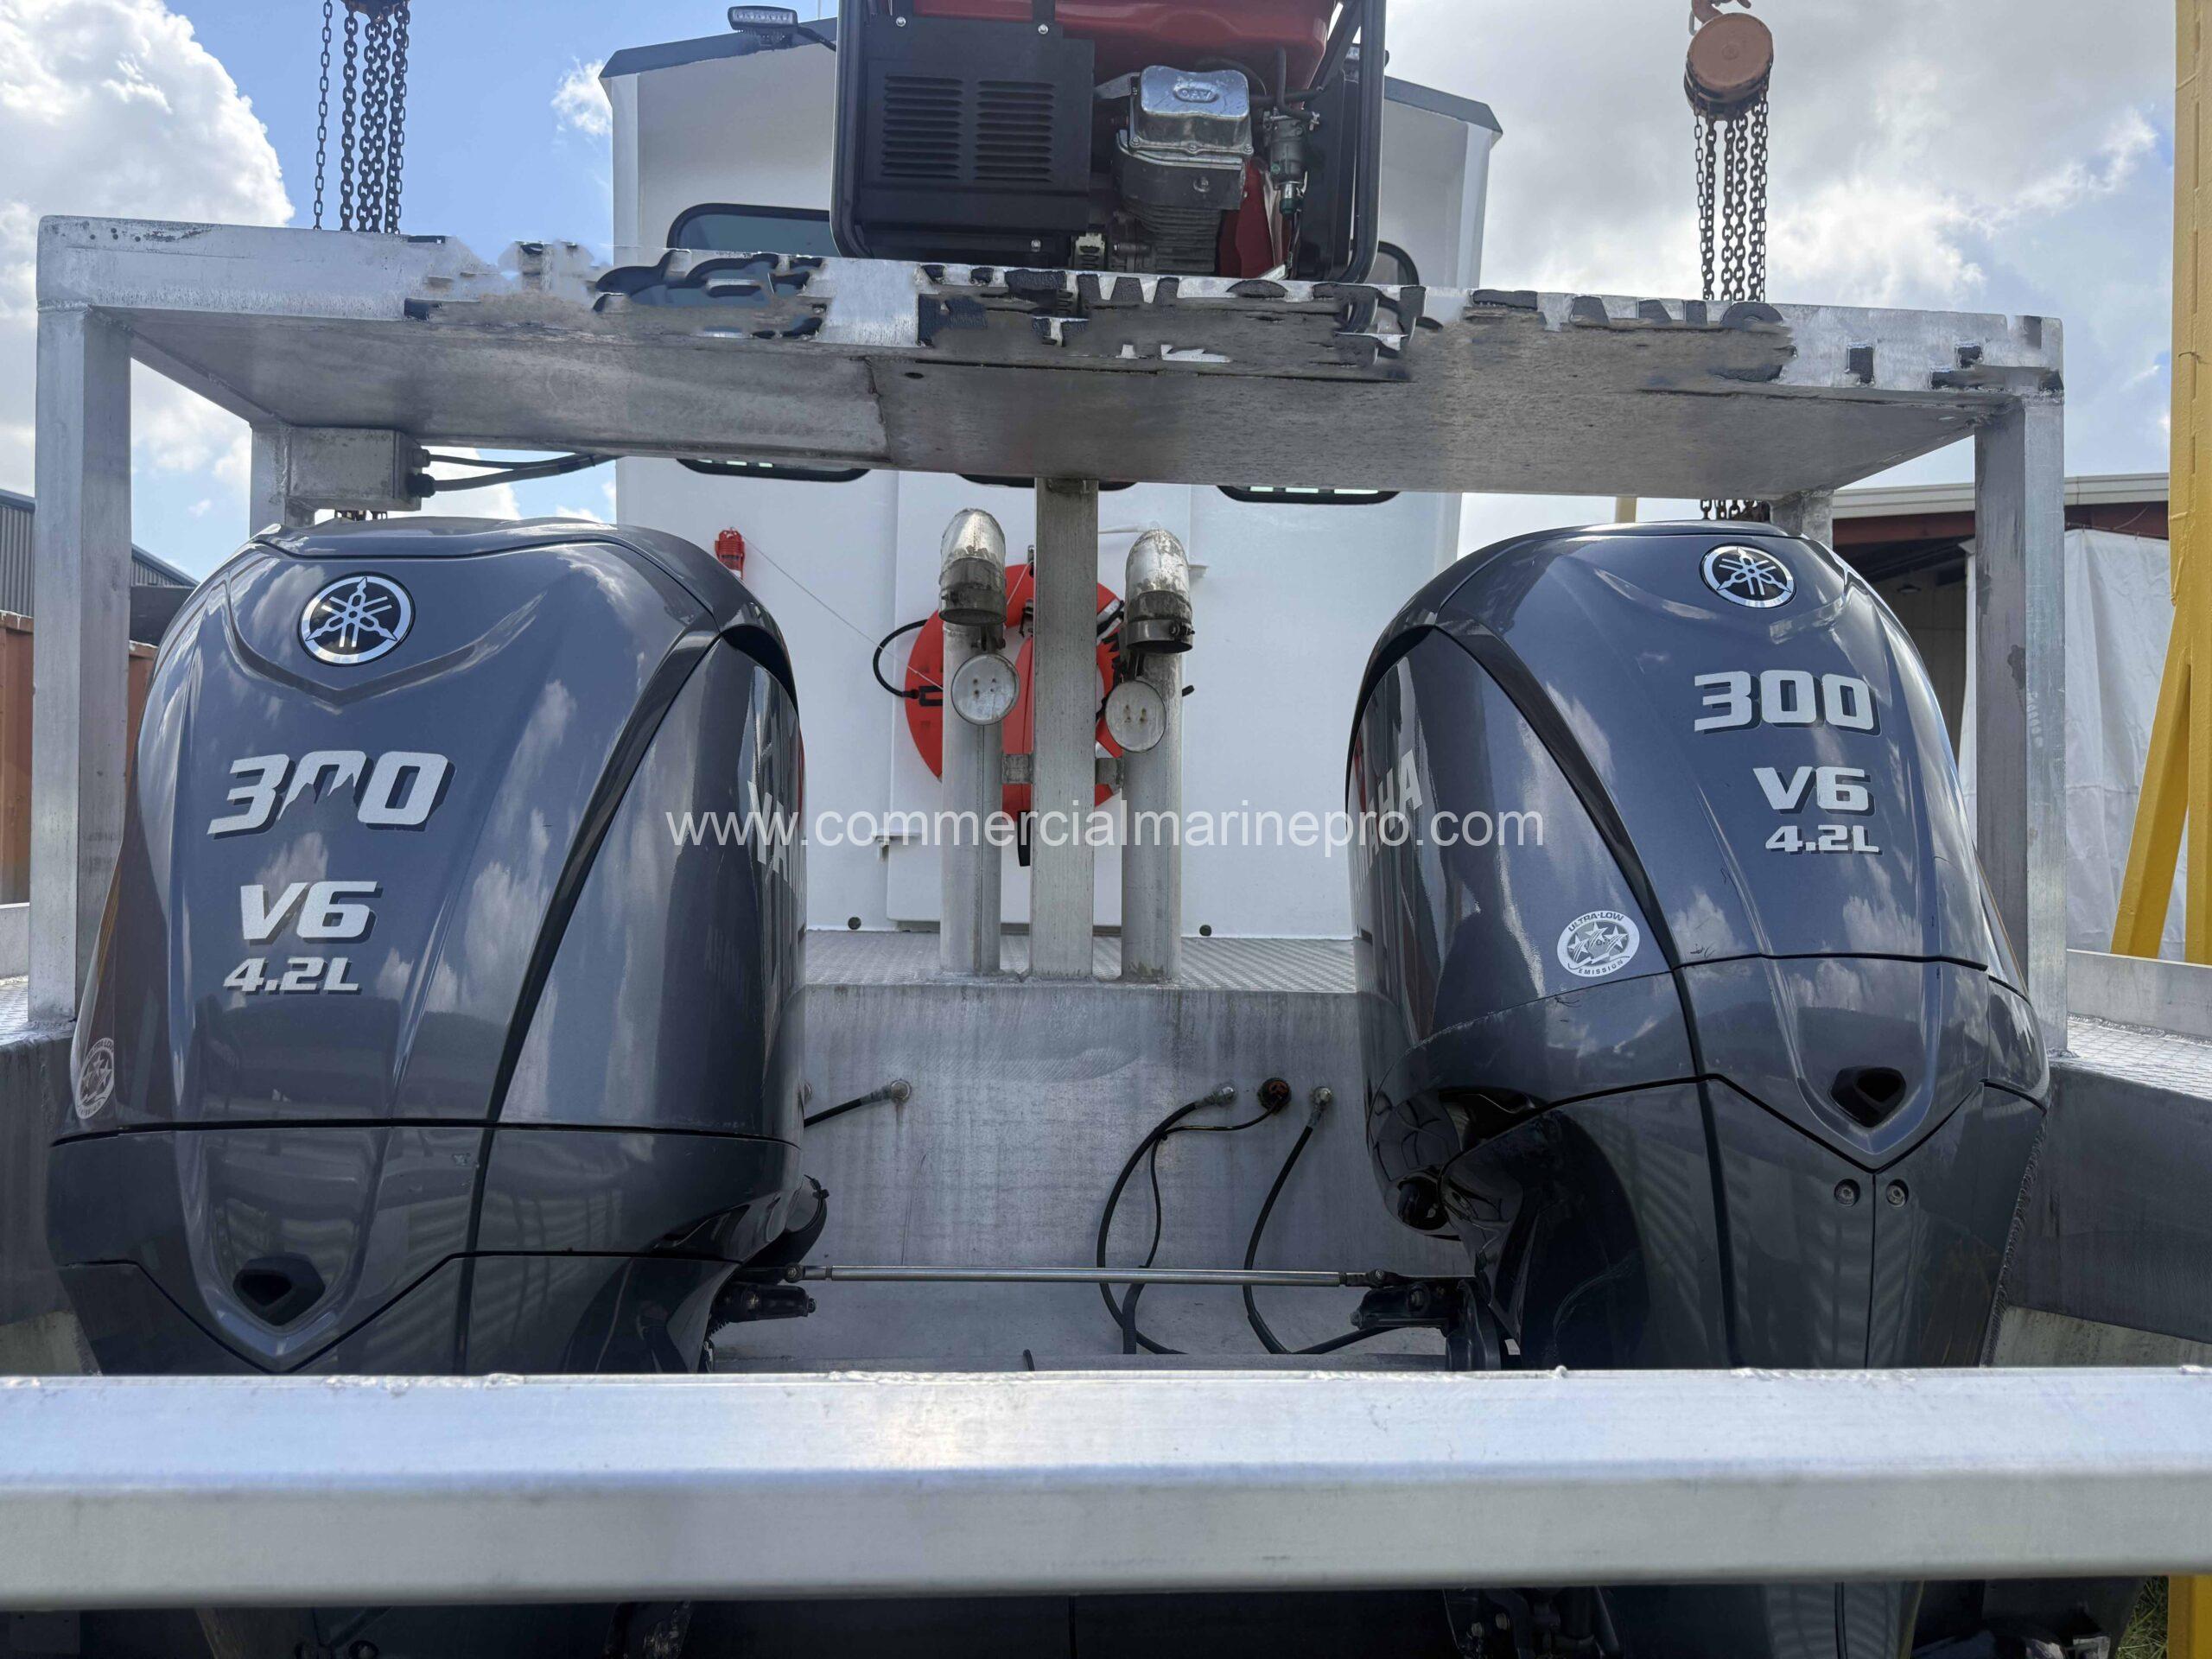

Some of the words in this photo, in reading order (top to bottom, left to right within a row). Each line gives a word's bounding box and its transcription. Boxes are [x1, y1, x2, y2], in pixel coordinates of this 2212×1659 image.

[1694, 670, 1881, 736] 300
[1752, 766, 1876, 817] V6
[1765, 824, 1883, 855] 4.2L
[240, 880, 383, 946] V6
[223, 957, 362, 995] 4.2L
[1578, 958, 1624, 976] EMISSION
